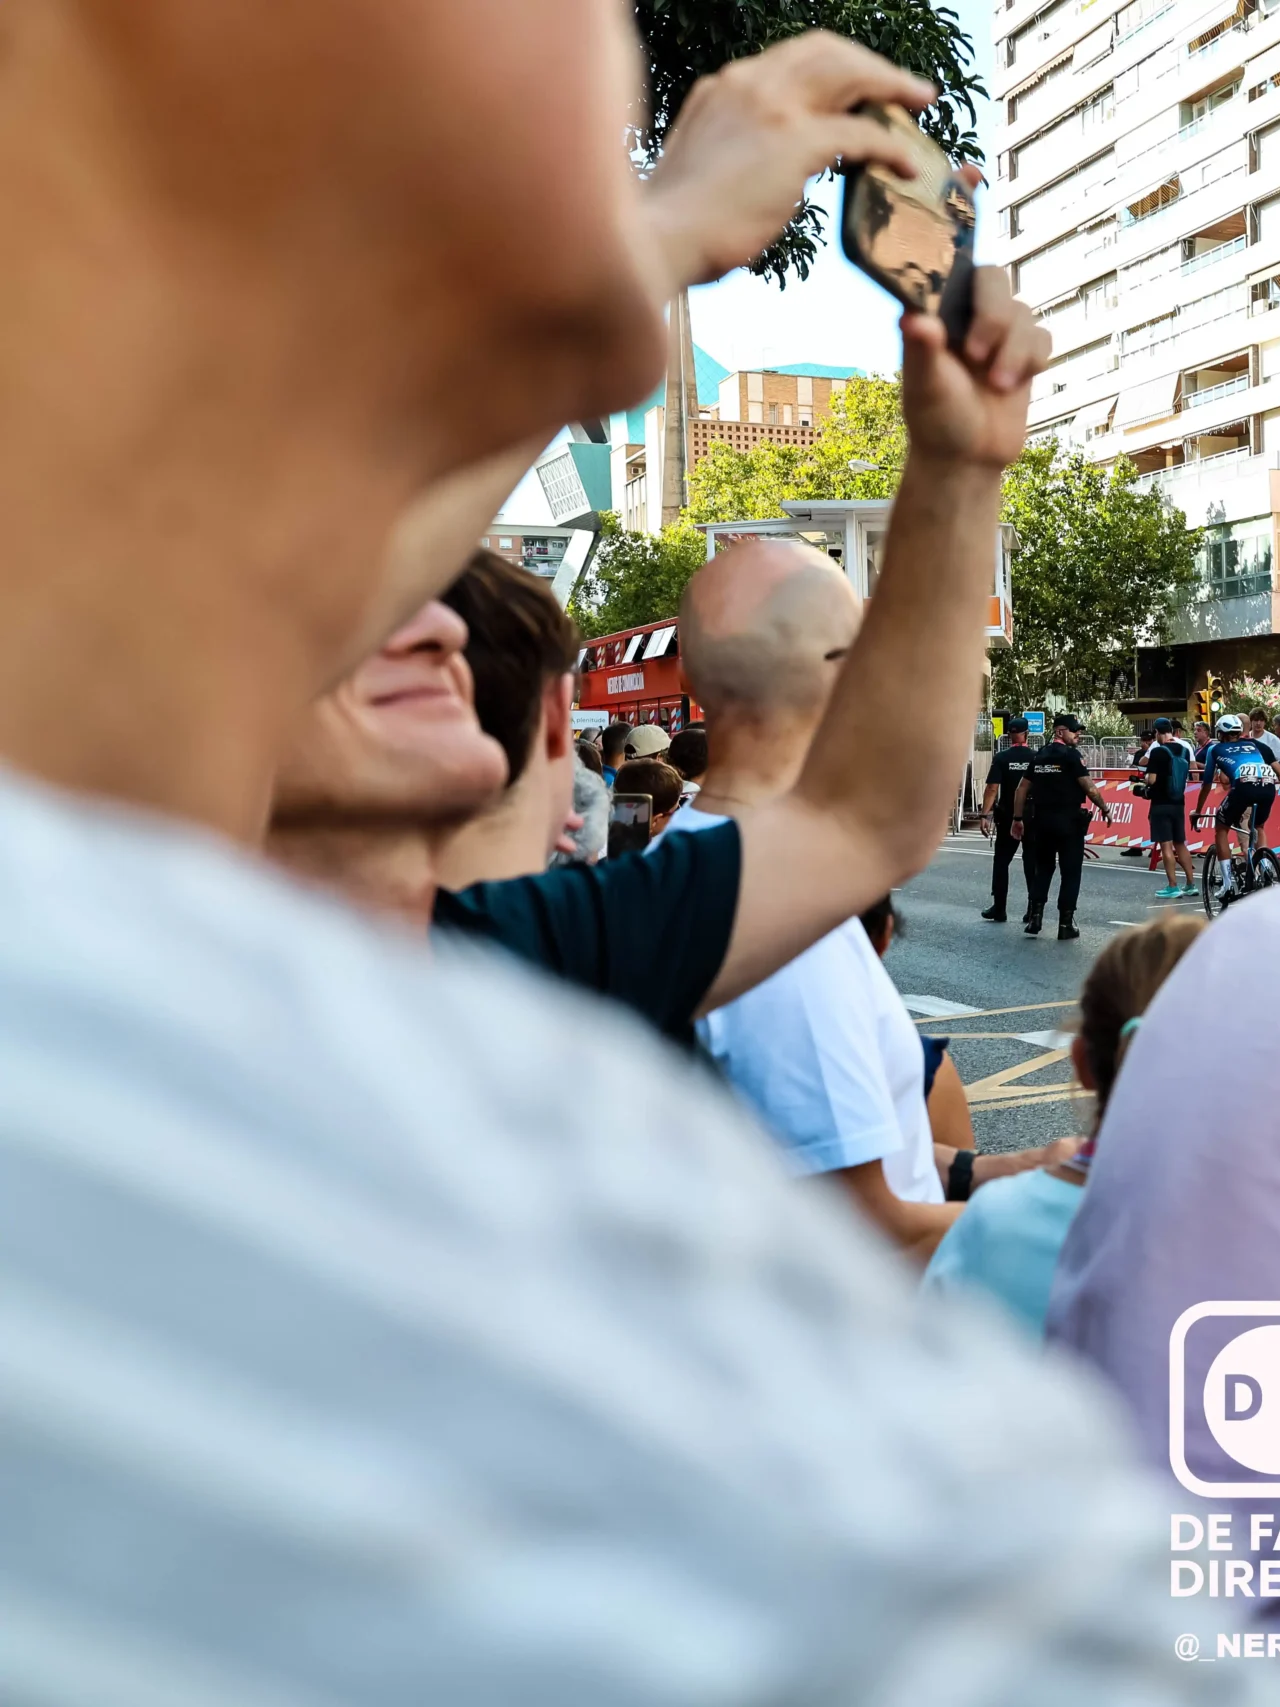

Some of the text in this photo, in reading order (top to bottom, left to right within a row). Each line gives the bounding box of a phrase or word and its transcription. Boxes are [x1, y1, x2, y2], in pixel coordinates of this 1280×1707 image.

[576, 716, 606, 724] plenitude
[1240, 765, 1275, 778] 227 22
